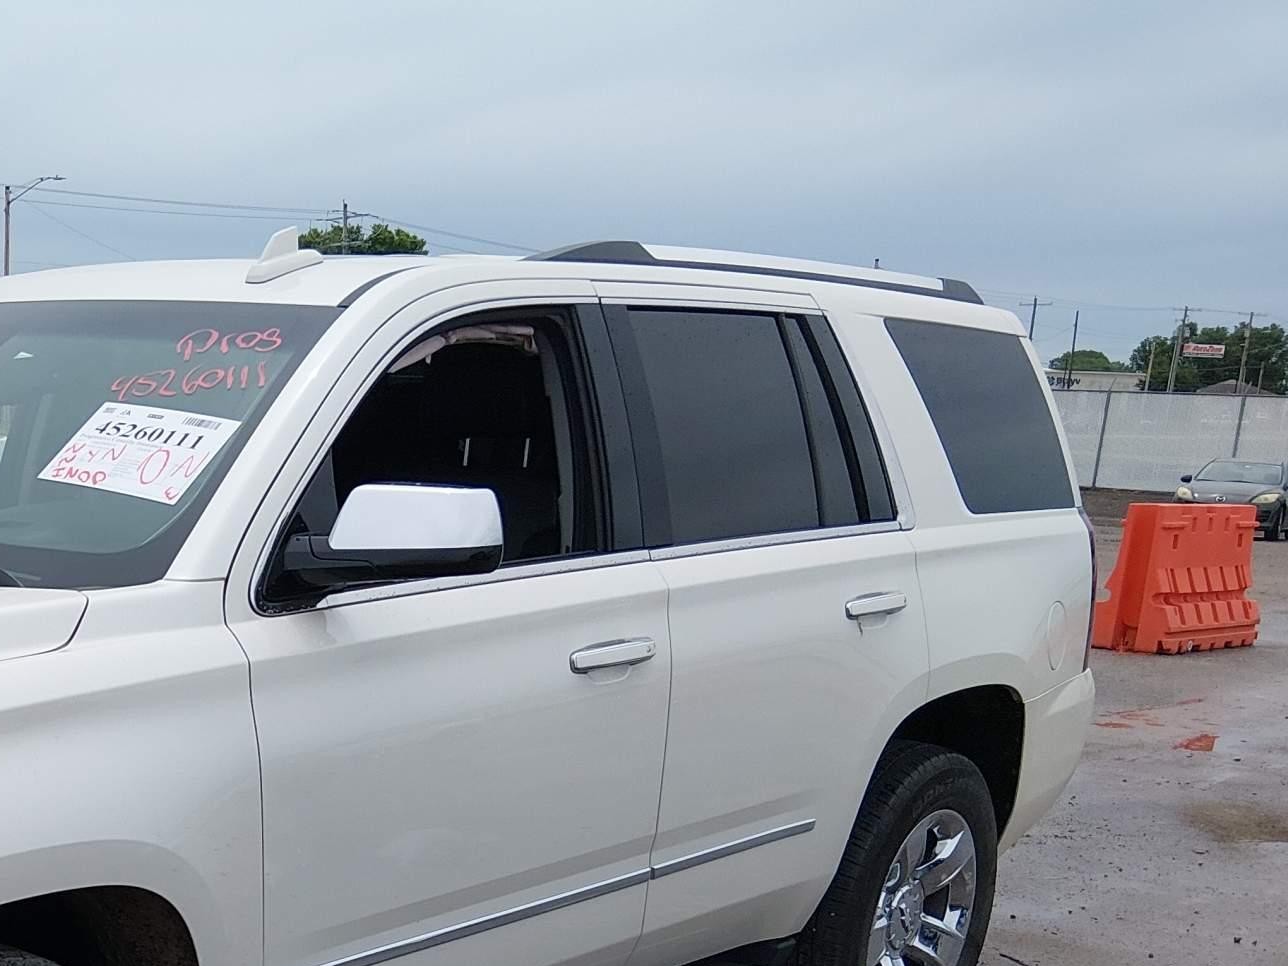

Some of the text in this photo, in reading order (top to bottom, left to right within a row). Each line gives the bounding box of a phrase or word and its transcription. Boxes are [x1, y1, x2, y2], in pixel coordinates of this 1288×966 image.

[111, 360, 266, 401] 45260111
[95, 420, 205, 450] 45260111
[51, 466, 107, 486] INOP
